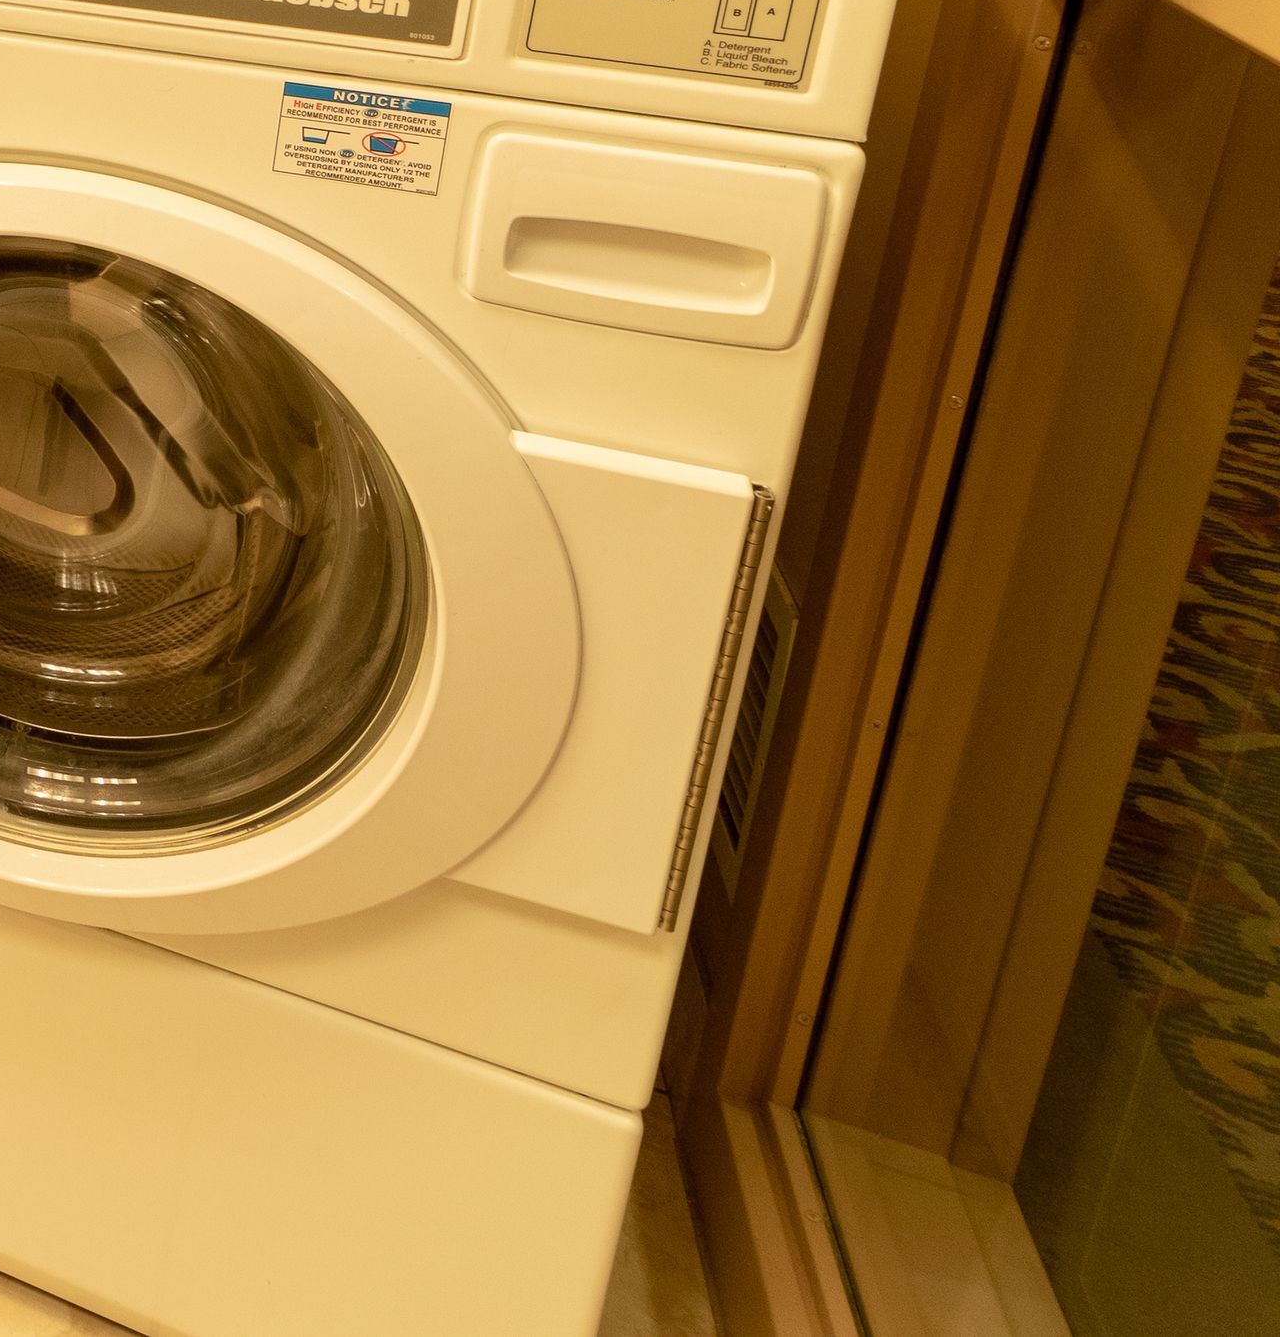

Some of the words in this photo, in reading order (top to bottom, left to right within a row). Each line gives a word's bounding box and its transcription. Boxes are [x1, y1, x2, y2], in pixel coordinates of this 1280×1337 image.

[732, 8, 741, 16] B
[703, 39, 714, 47] A.
[718, 40, 771, 54] Detergent
[702, 47, 712, 56] B.
[716, 50, 751, 61] Liquid
[751, 53, 787, 65] Bleach
[699, 56, 711, 65] C.
[715, 58, 748, 70] Fabric
[751, 63, 797, 75] Softener
[333, 90, 399, 108] NOTICE
[293, 99, 313, 109] HIGH
[315, 102, 360, 115] EFFICIENCY
[381, 113, 427, 124] DETERGENT
[286, 108, 343, 121] RECOMMENDED
[362, 118, 381, 126] BEST
[383, 121, 440, 135] PERFORMANCE
[284, 151, 338, 164] OVERSUDSING
[353, 161, 377, 169] USING
[293, 145, 317, 153] USING
[319, 148, 336, 156] NON
[407, 162, 431, 170] AVOID
[296, 160, 342, 171] DETERGENT
[305, 169, 366, 182] RECOMMENDED
